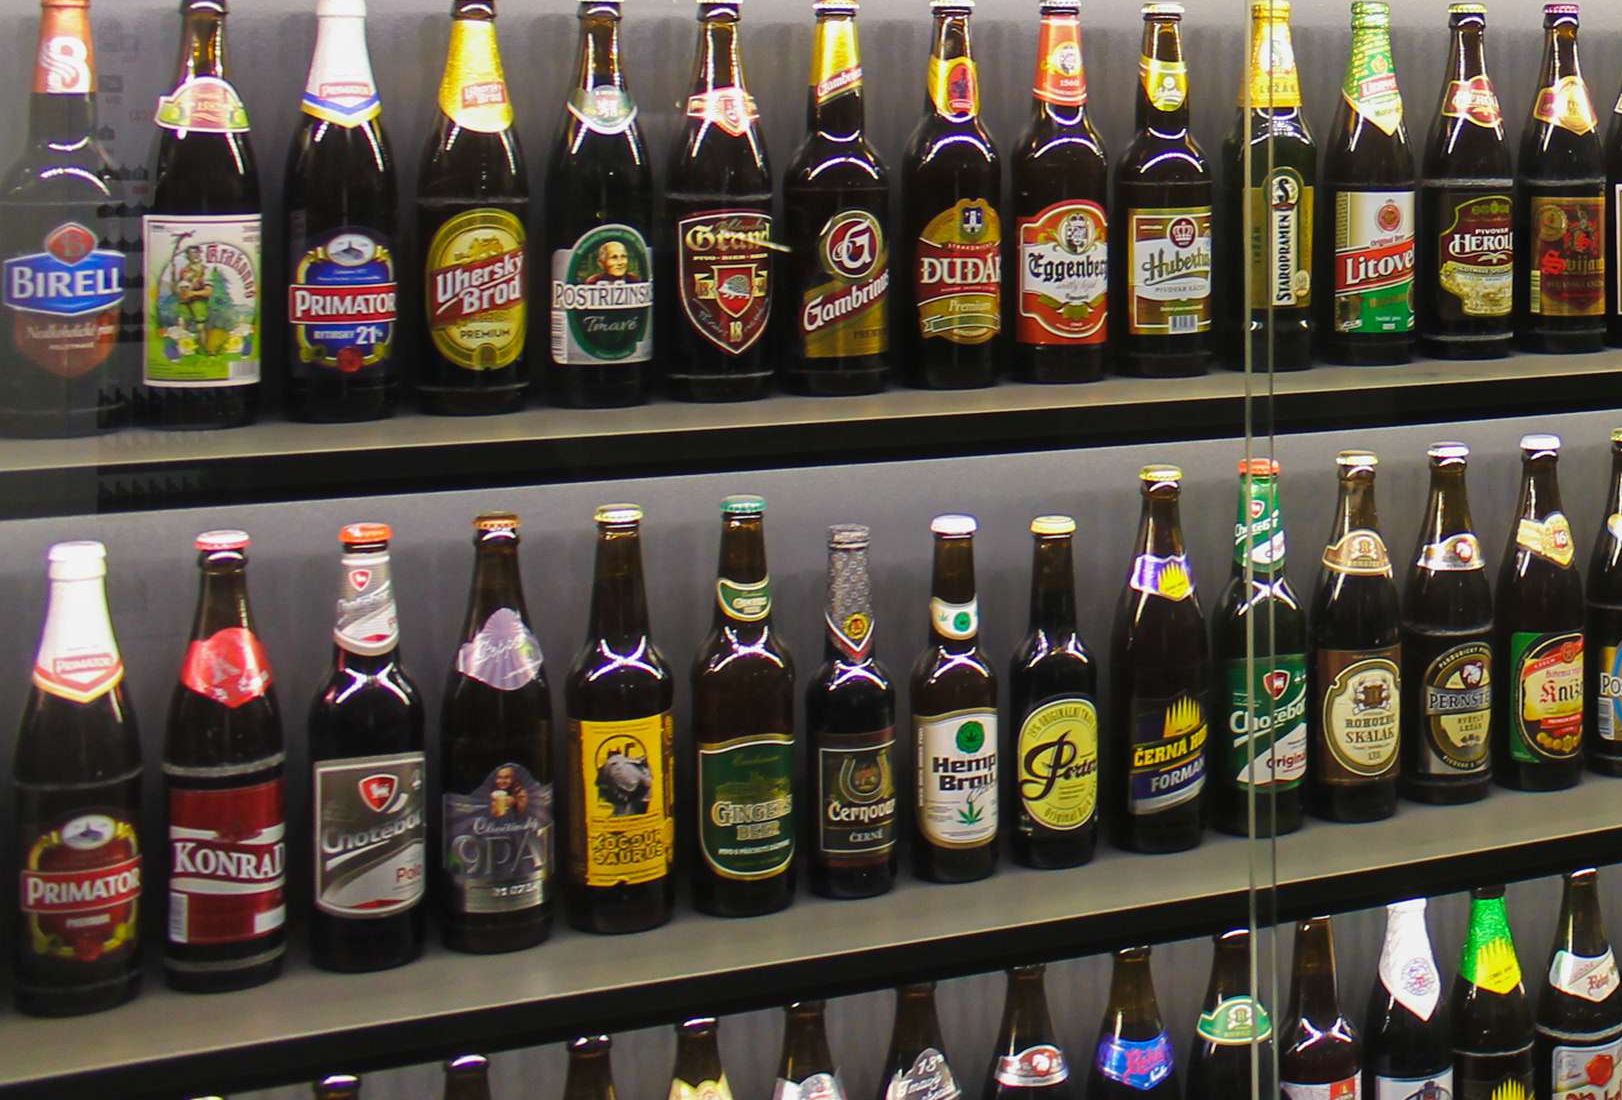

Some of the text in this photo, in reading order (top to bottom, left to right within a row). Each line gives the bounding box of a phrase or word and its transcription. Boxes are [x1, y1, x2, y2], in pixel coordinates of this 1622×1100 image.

[1275, 210, 1293, 303] STAROPRAMEN
[1346, 245, 1414, 287] Litovel
[11, 265, 124, 302] BIRELL
[435, 250, 524, 304] Uherský
[294, 286, 397, 319] PRIMATOR
[459, 280, 522, 316] Brod
[802, 269, 891, 333] Gambrinus
[947, 298, 992, 312] Premium
[459, 327, 511, 339] PREMIUM
[1133, 735, 1188, 767] ČERNÁ
[1345, 728, 1396, 747] SKALÁK
[932, 755, 996, 777] Hemp
[736, 821, 780, 841] BEER
[27, 866, 141, 906] PRIMATOR
